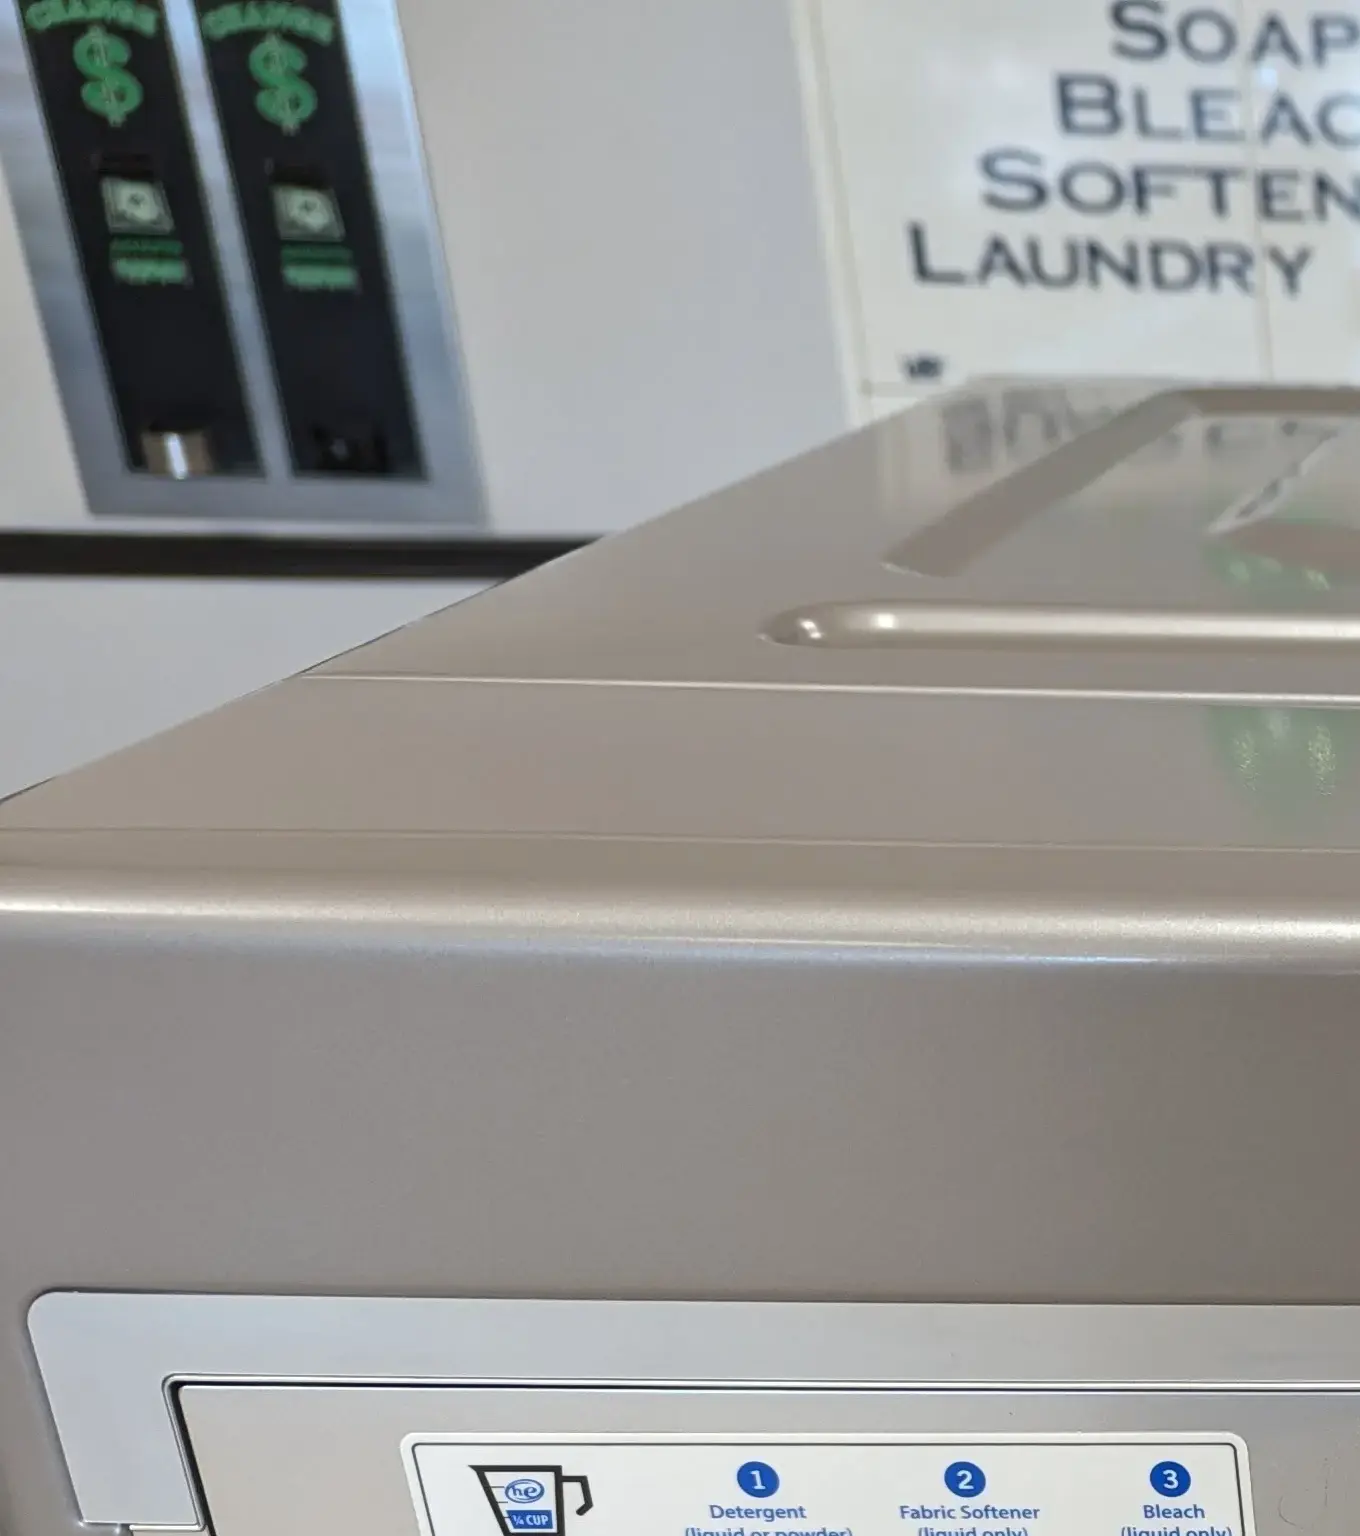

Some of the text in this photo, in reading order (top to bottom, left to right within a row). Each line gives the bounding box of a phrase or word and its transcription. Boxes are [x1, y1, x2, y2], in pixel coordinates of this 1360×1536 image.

[907, 221, 1315, 297] LAUNDRY
[750, 1470, 766, 1490] 1
[956, 1470, 975, 1490] 2
[1163, 1469, 1179, 1489] 3
[526, 1514, 549, 1526] CUP
[709, 1504, 807, 1522] Detergent
[899, 1504, 1040, 1519] Fabric Softener
[1143, 1504, 1206, 1519] Bleach
